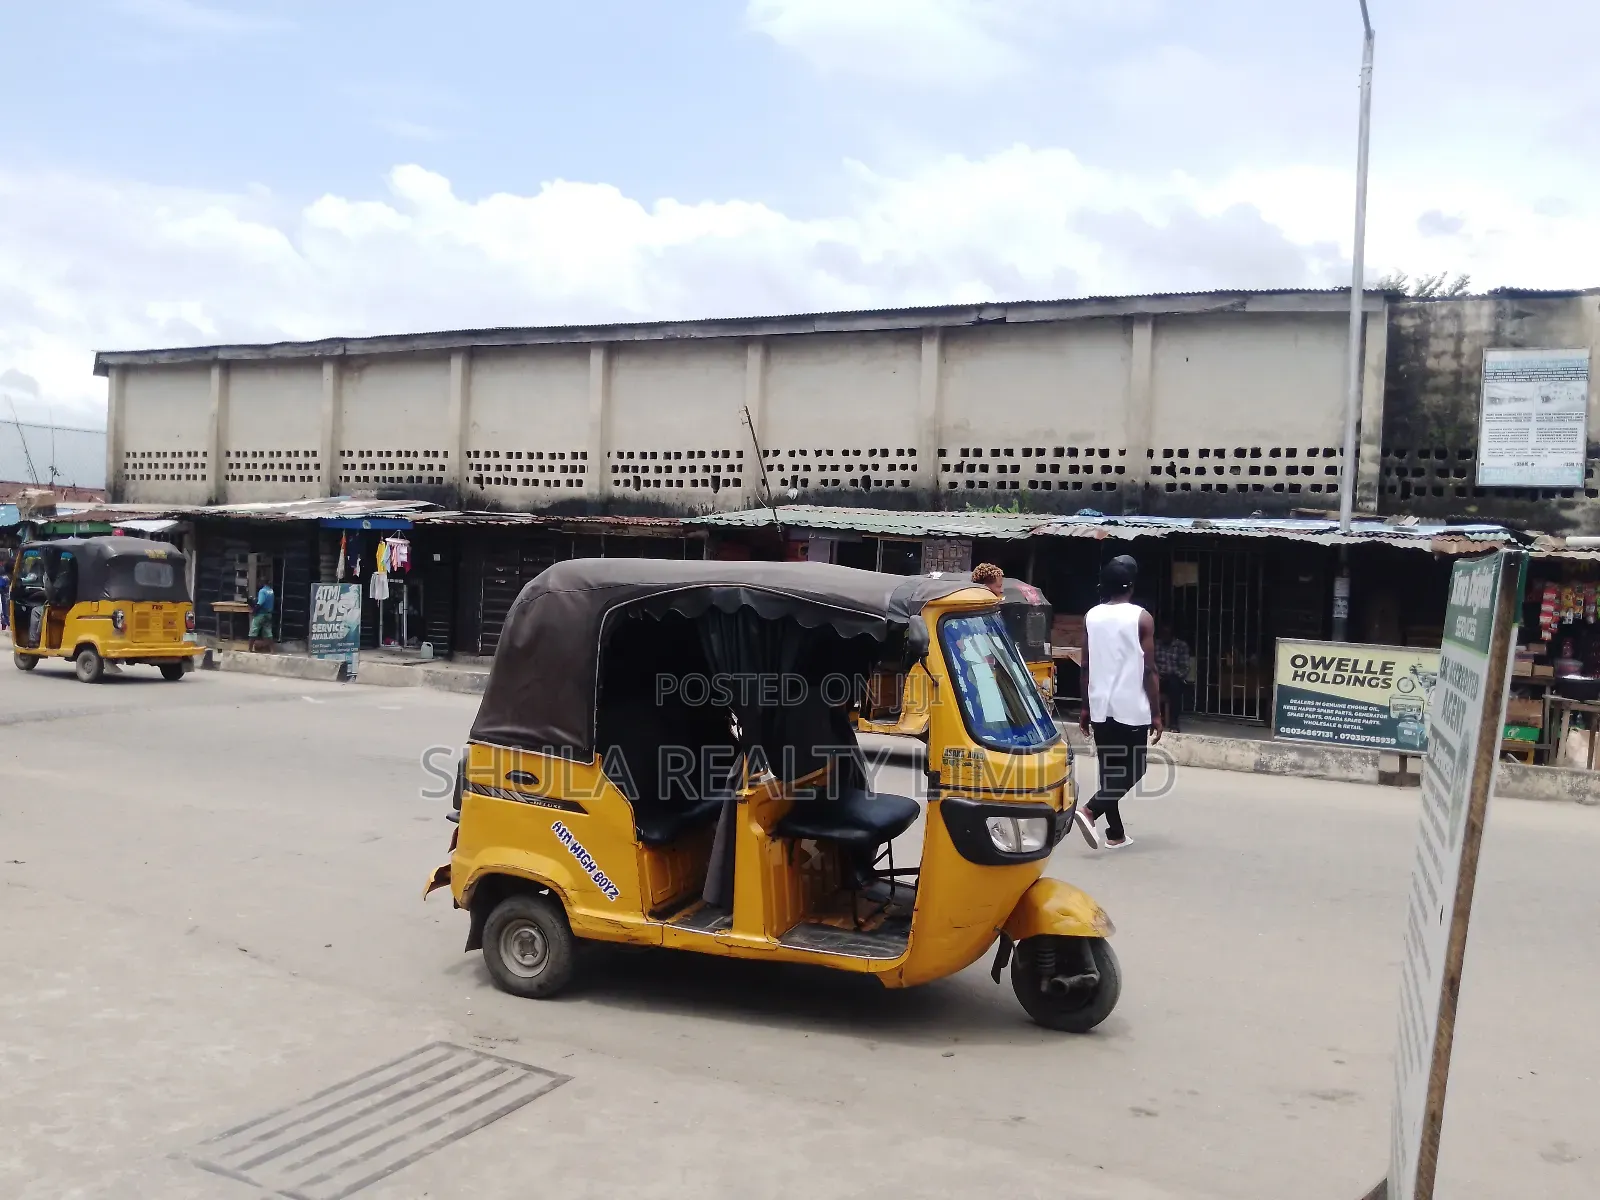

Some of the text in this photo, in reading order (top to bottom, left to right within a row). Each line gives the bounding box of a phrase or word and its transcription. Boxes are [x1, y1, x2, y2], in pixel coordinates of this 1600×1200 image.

[313, 600, 348, 622] POS
[312, 623, 345, 632] SERVICE
[312, 632, 345, 640] AVAILABLE
[1290, 654, 1396, 676] OWELLE
[1291, 670, 1392, 689] HOLDINGS
[1441, 687, 1467, 738] AGENT
[1303, 720, 1336, 728] WHOLESALE
[552, 821, 619, 901] AIM HIGH BOYZ
